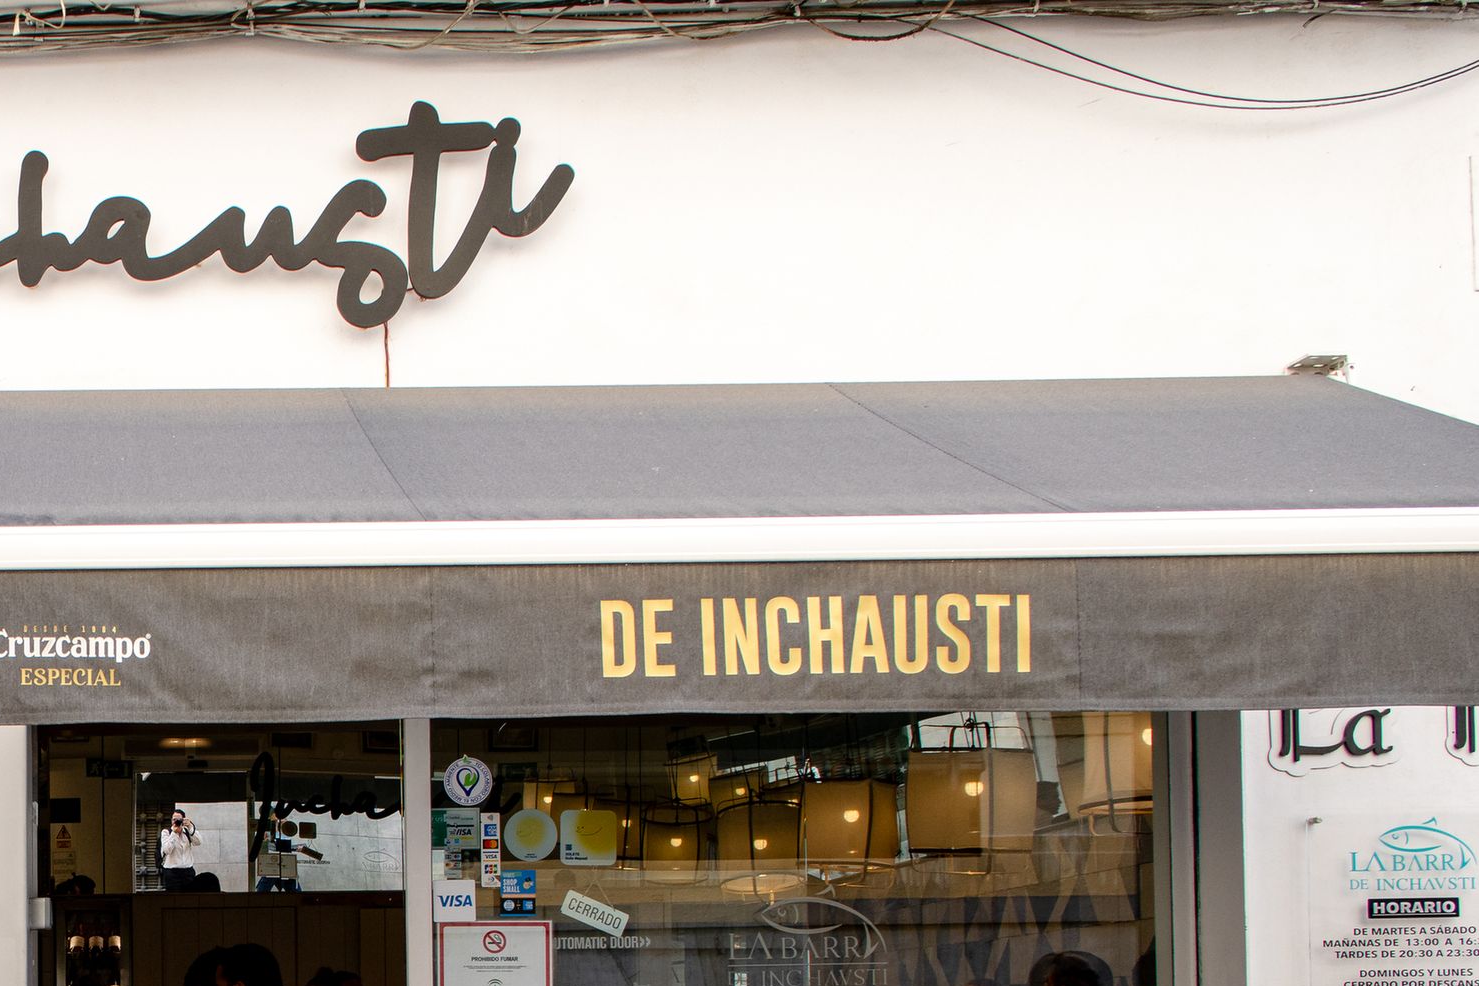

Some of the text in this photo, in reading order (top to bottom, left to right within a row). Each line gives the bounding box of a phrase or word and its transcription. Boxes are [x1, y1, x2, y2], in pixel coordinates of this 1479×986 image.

[600, 593, 1031, 678] DE INCHAUSTI
[20, 668, 122, 687] ESPECIAL
[1349, 851, 1386, 872] LA
[1349, 879, 1369, 890] DE
[437, 895, 473, 907] VISA
[567, 897, 622, 930] CERRADO
[1372, 901, 1456, 914] HORARIO
[1353, 924, 1477, 936] DE MARTES A SÁBADO
[610, 936, 639, 949] DOOR
[1322, 937, 1479, 948] MAÑANAS DE 13:00 A 16:
[1335, 949, 1479, 959] TARDES DE 20:30 A 23:30
[1359, 968, 1474, 978] DOMINGOS Y LUNES
